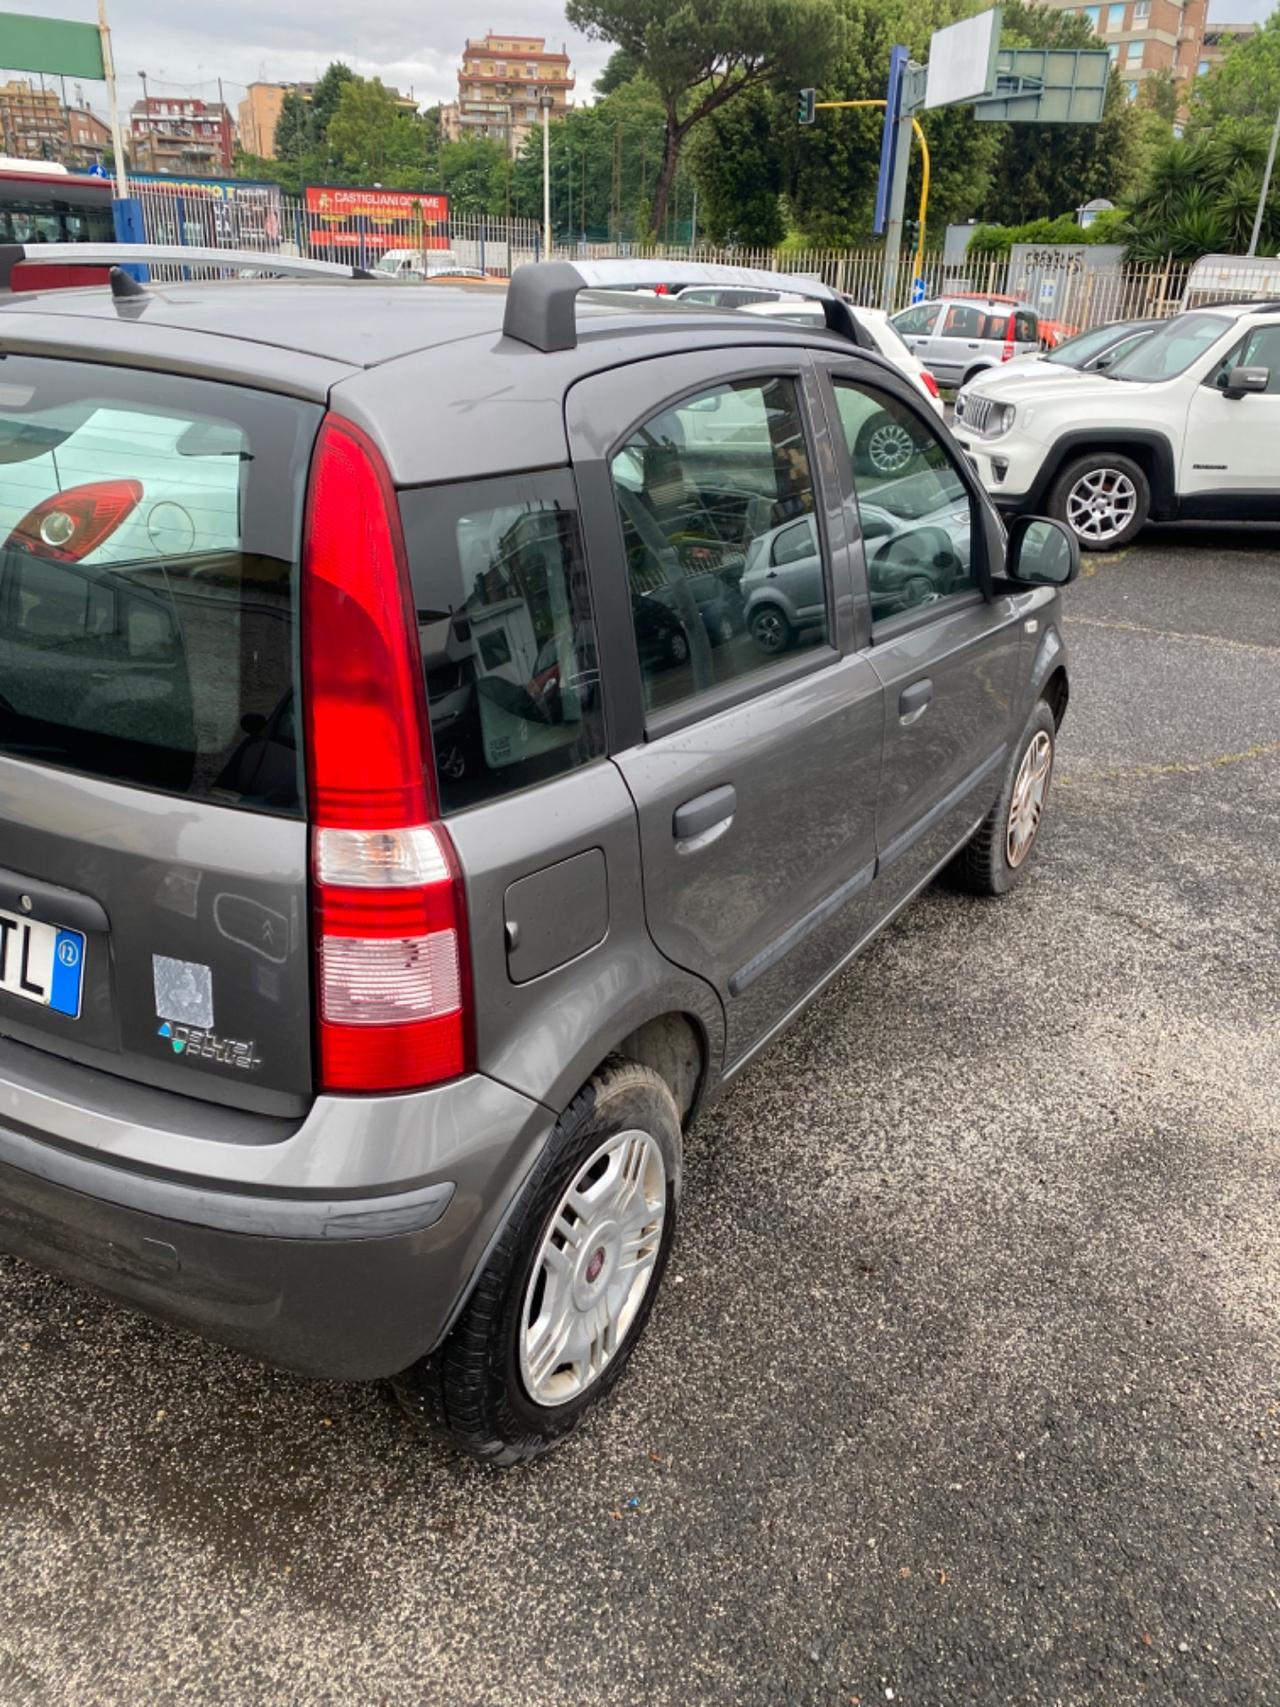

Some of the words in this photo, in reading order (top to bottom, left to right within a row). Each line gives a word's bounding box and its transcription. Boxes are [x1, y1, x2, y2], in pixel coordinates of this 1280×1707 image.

[334, 192, 398, 206] CASTIGLIANI
[400, 196, 439, 208] GOME
[60, 943, 75, 963] 12
[175, 1026, 254, 1058] natural
[186, 1042, 261, 1069] power
